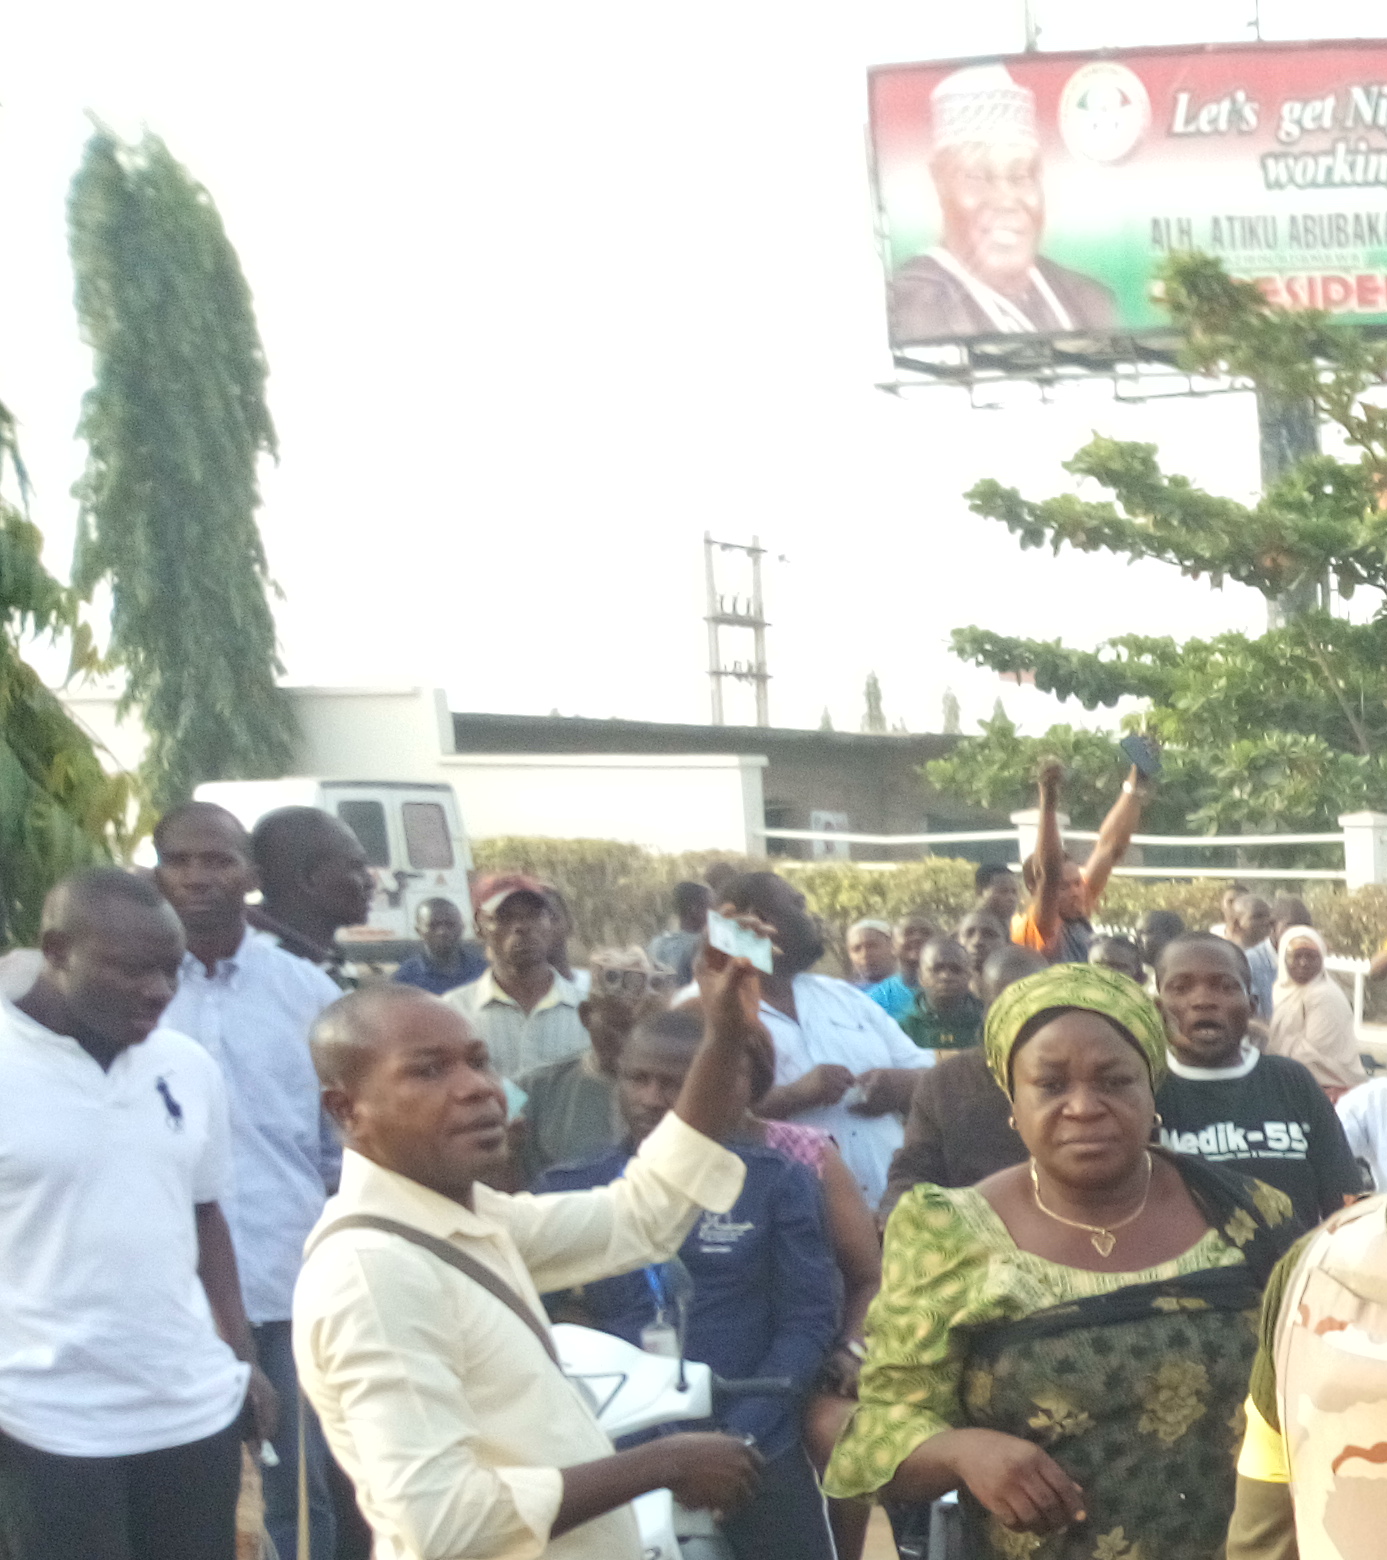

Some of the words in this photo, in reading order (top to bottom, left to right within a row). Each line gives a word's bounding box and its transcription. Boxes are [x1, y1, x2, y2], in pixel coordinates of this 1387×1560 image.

[1169, 89, 1259, 135] Let's
[1278, 94, 1335, 143] get
[1210, 214, 1278, 250] ATIKU
